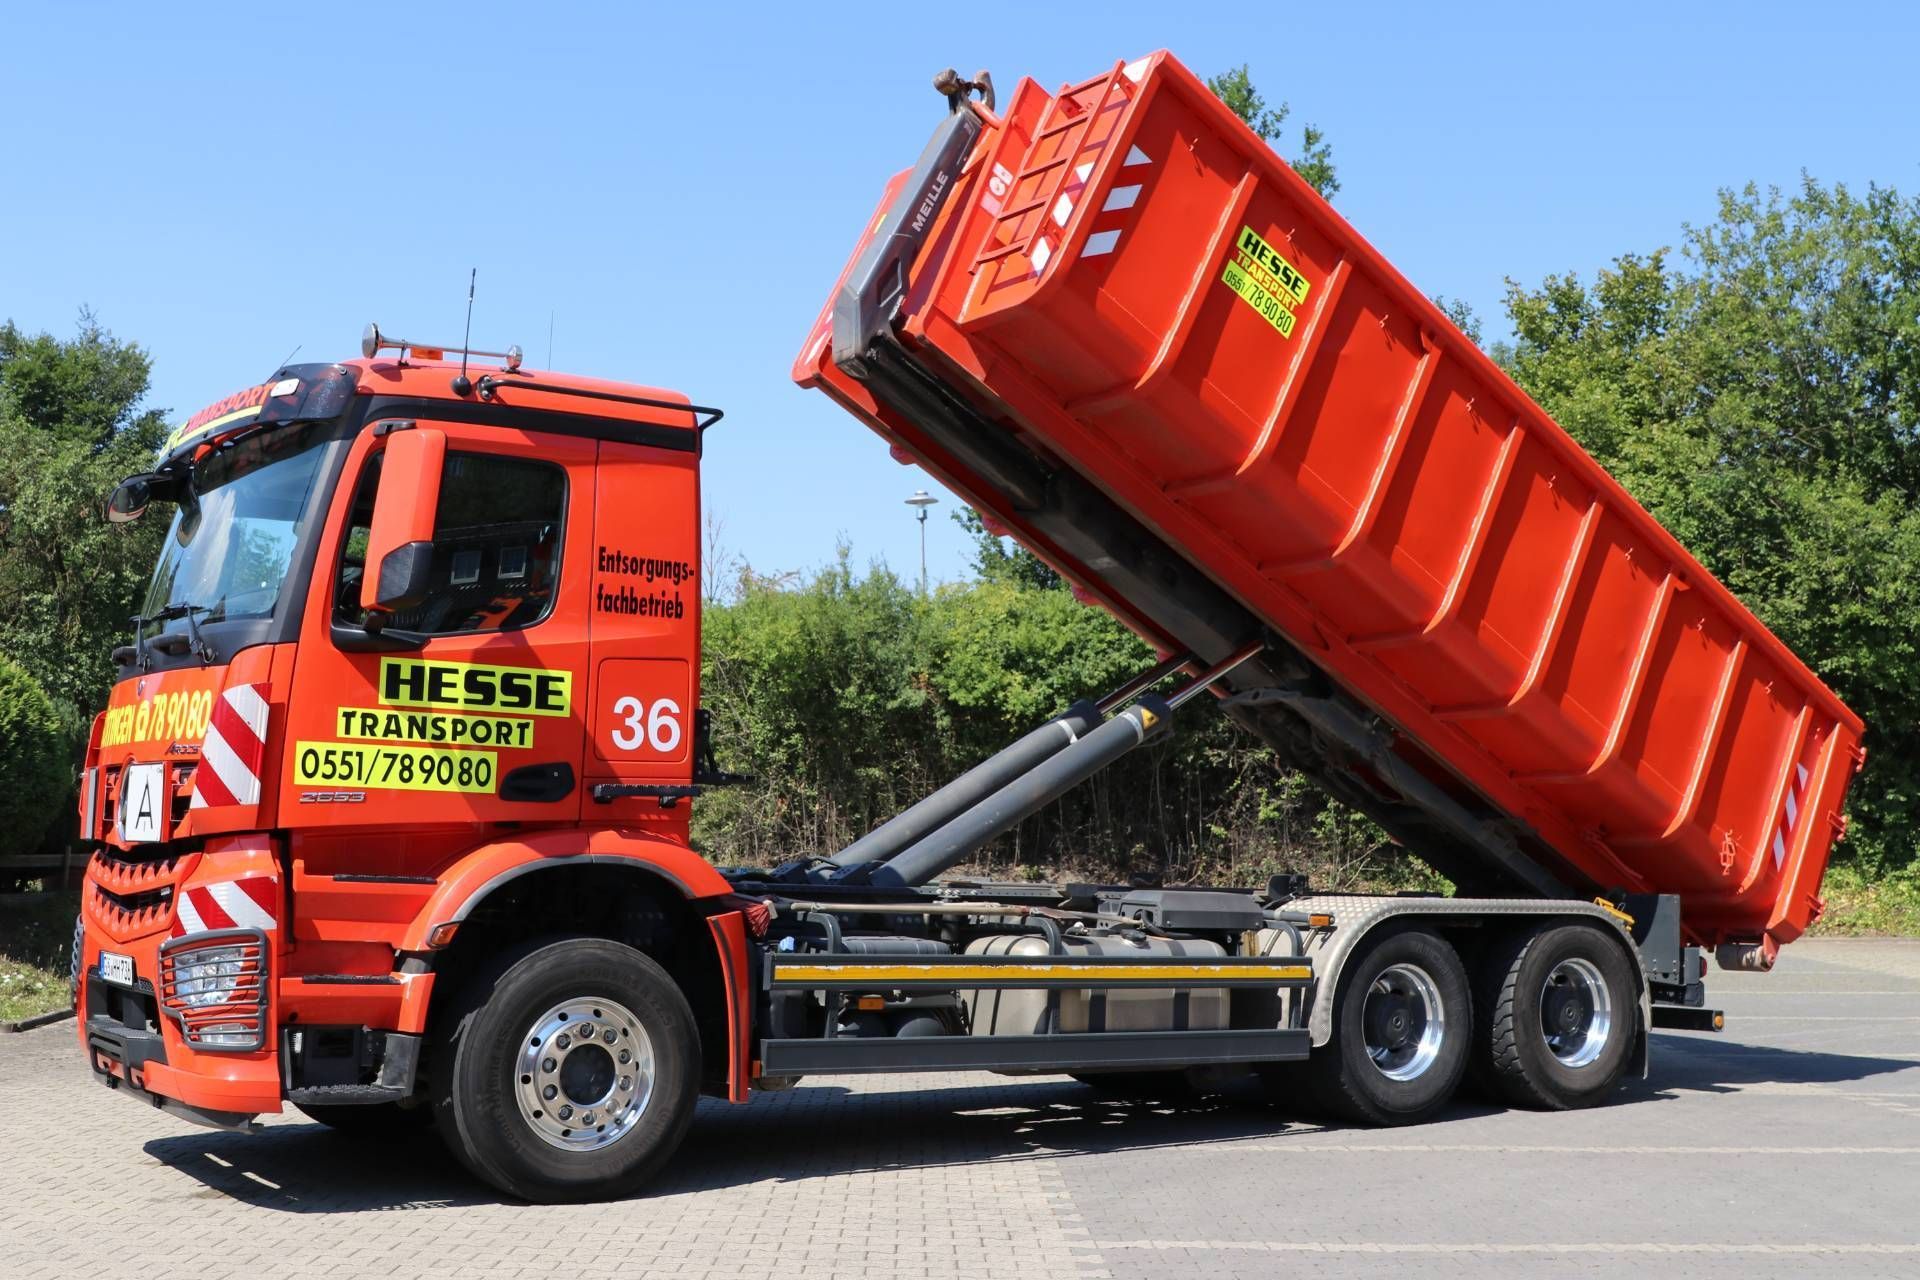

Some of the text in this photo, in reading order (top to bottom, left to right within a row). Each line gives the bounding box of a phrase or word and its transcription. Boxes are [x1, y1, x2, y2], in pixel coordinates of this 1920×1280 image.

[911, 171, 949, 232] MEILLE
[1236, 250, 1298, 312] TRANSPORT
[1243, 232, 1305, 298] HESSE
[598, 546, 695, 586] Entsorgungs-
[596, 583, 684, 619] fachbetrieb
[384, 663, 566, 712] HESSE
[341, 710, 531, 746] TRANSPORT
[611, 696, 681, 753] 36
[134, 773, 154, 830] A
